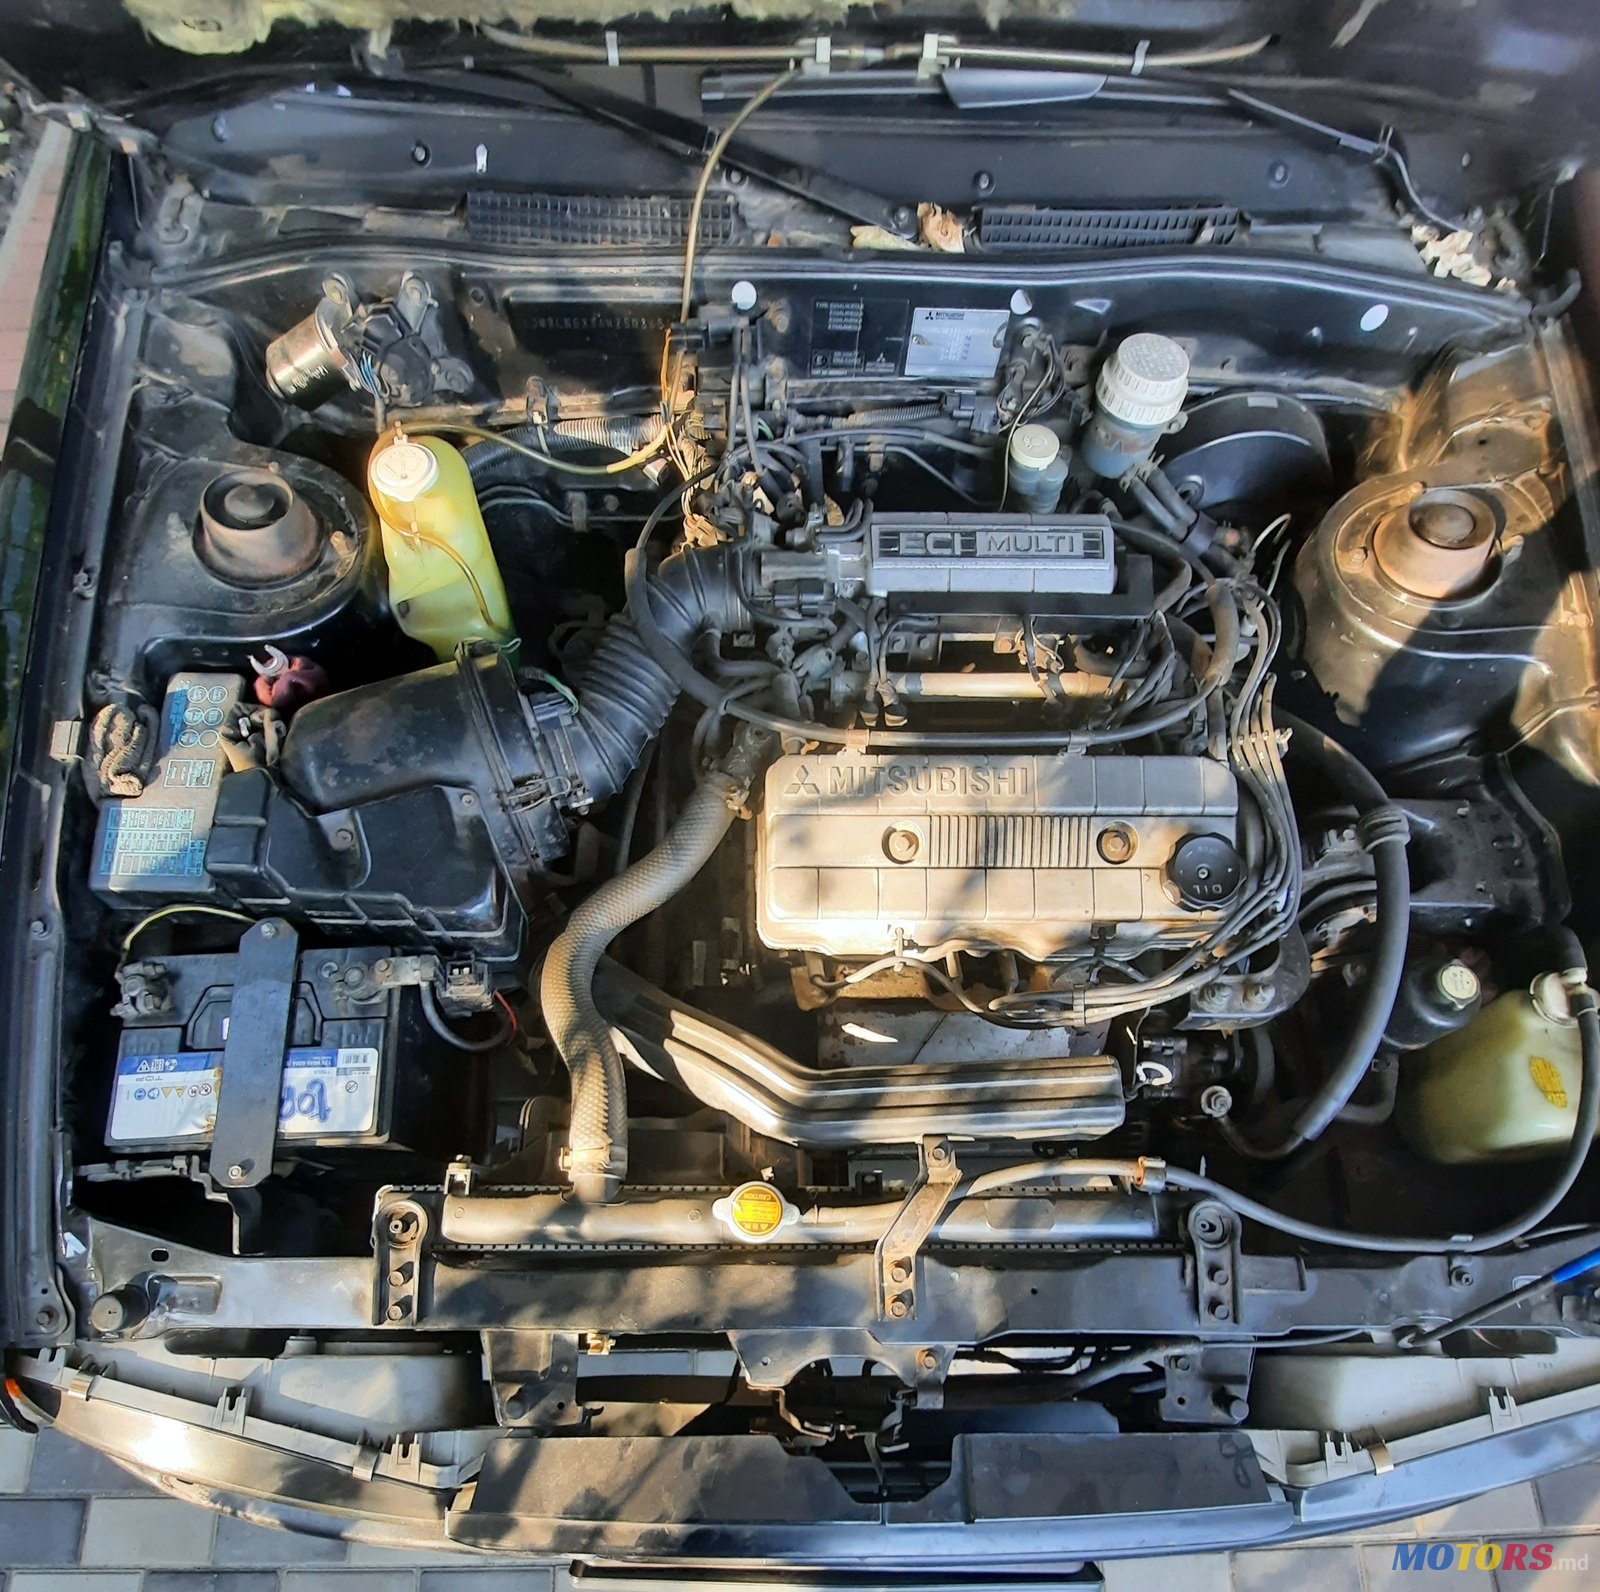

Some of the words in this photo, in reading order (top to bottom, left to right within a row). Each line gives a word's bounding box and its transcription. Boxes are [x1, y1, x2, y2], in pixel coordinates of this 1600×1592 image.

[899, 531, 963, 556] ECI
[986, 534, 1075, 554] MULTI
[828, 764, 1029, 796] MITSUBISHI
